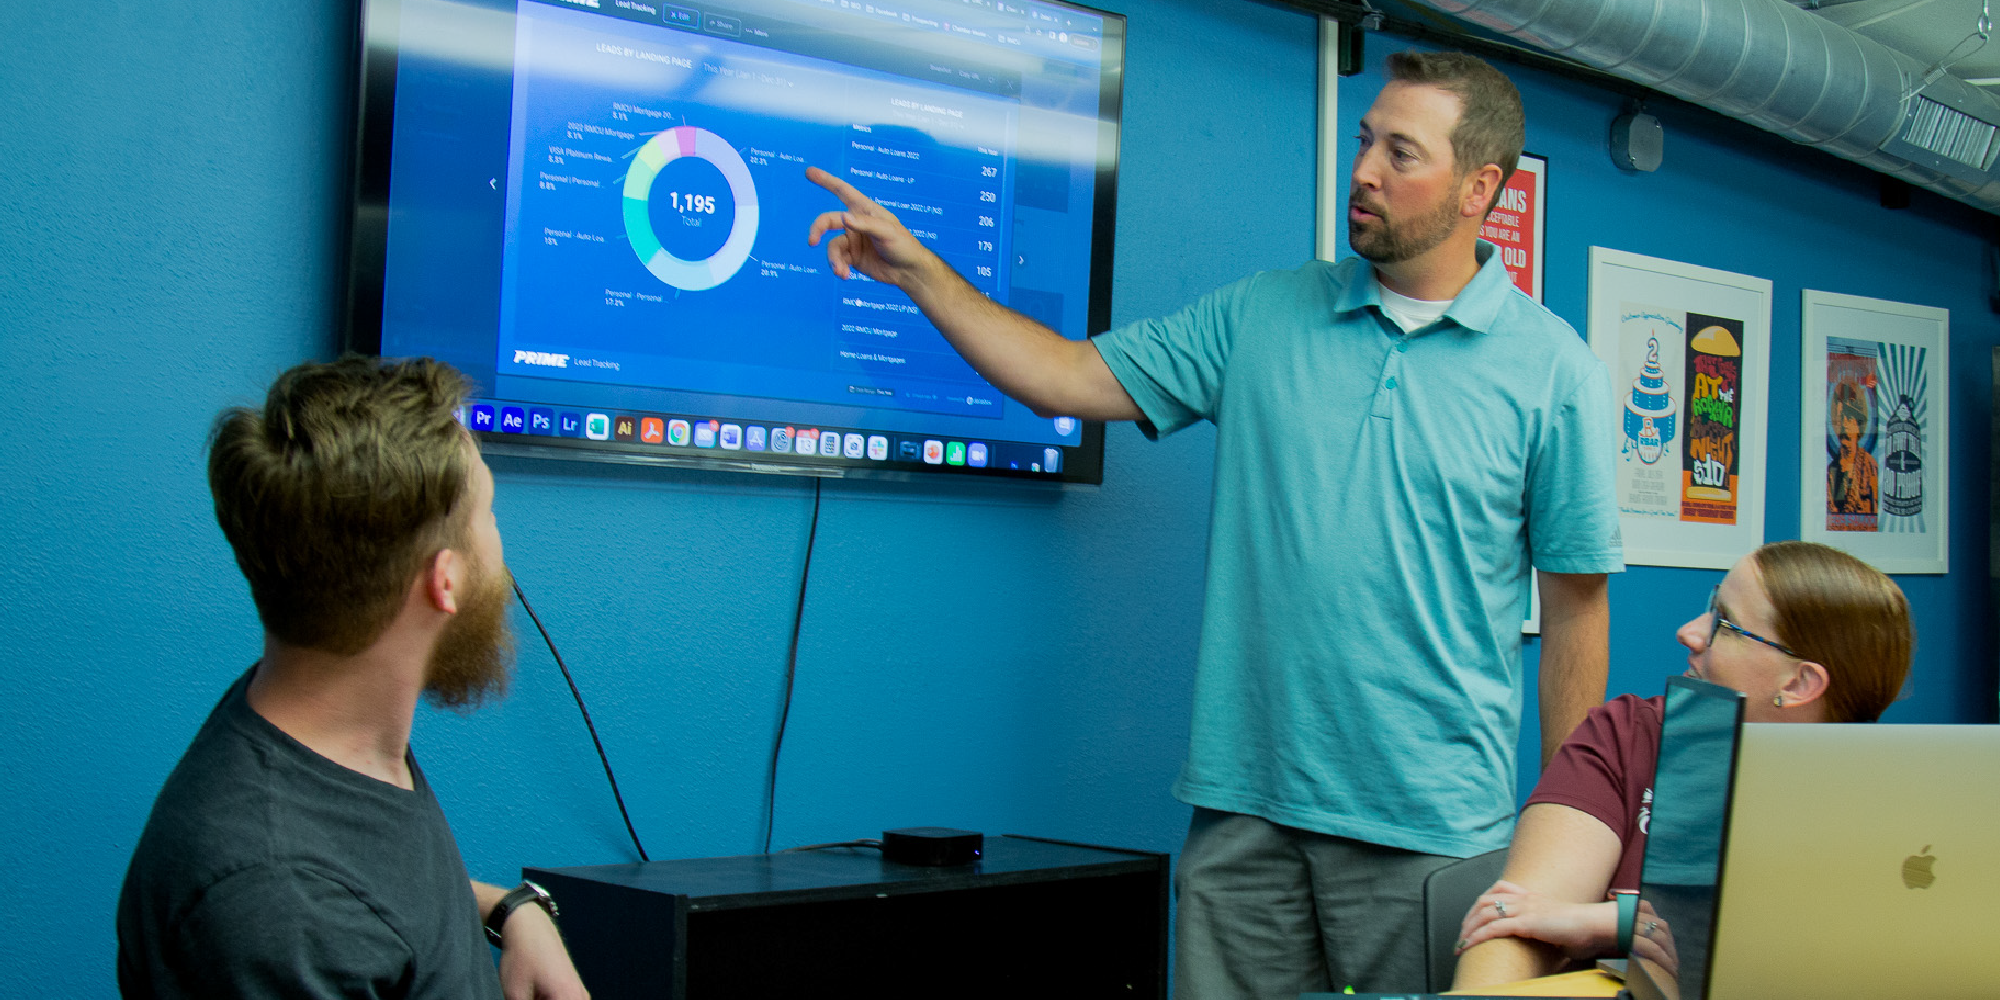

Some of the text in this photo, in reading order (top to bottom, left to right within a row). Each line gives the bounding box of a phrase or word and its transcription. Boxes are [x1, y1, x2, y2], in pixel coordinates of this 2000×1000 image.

[596, 43, 692, 69] LEADS BY LANDING PAGE
[604, 126, 635, 139] Mortgage
[851, 140, 874, 151] Personal
[750, 147, 775, 158] Personal
[539, 171, 568, 183] Personal
[850, 167, 872, 177] Personal
[981, 166, 997, 178] 267
[670, 191, 716, 214] 1,195
[980, 190, 996, 203] 250
[1496, 188, 1527, 214] ANS
[682, 215, 702, 228] Total
[979, 216, 995, 227] 206
[1487, 211, 1520, 228] CEPTABLE
[544, 227, 572, 238] Personal
[978, 240, 992, 252] 179
[761, 260, 785, 270] Personal
[1504, 249, 1527, 269] OLD
[977, 265, 991, 277] 105
[605, 289, 632, 299] Personal
[840, 351, 855, 359] Home
[1647, 337, 1659, 364] 2
[513, 350, 620, 371] PRIME Lead Tracking
[1694, 372, 1723, 400] AT
[477, 411, 492, 425] Pr
[503, 413, 522, 428] Ae
[533, 413, 550, 429] Ps
[563, 417, 578, 431] Lr
[618, 422, 632, 435] Ai
[1693, 453, 1725, 487] $10
